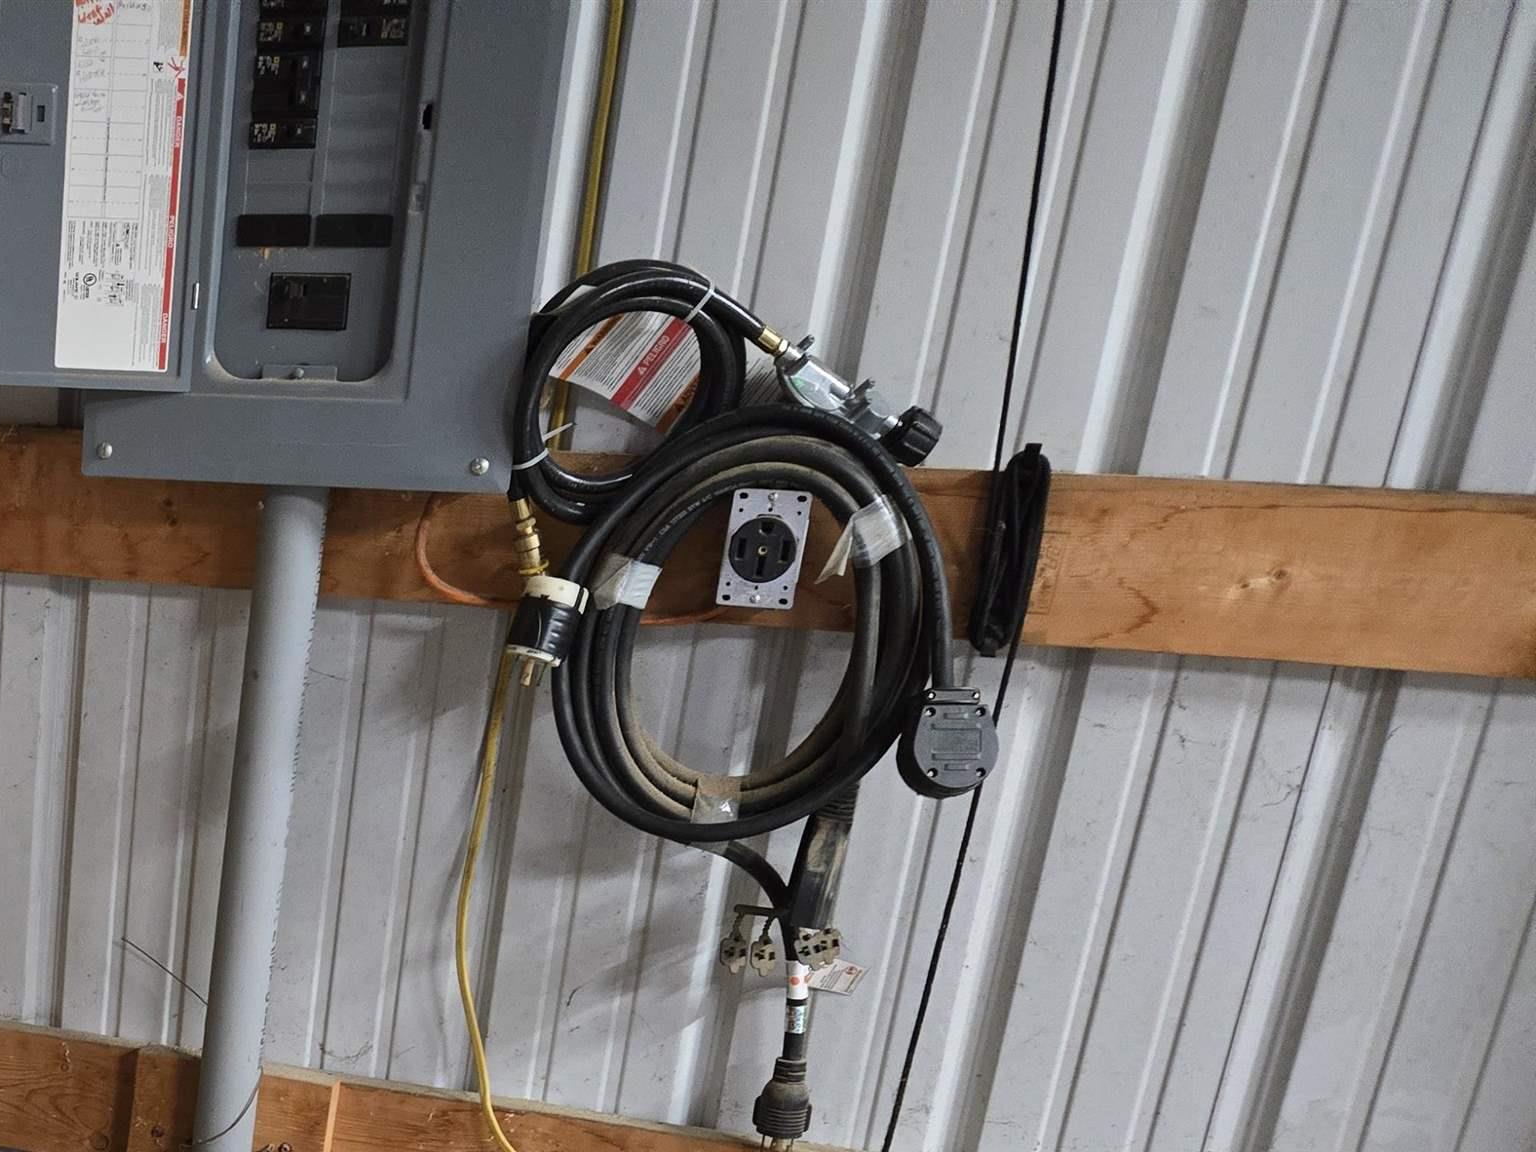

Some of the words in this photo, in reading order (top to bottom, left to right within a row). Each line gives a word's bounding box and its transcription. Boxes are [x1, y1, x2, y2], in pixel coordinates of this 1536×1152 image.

[174, 116, 183, 147] DANGER
[167, 216, 175, 248] PELIGRO
[161, 313, 169, 343] DANGER
[646, 335, 670, 367] PELIGRO
